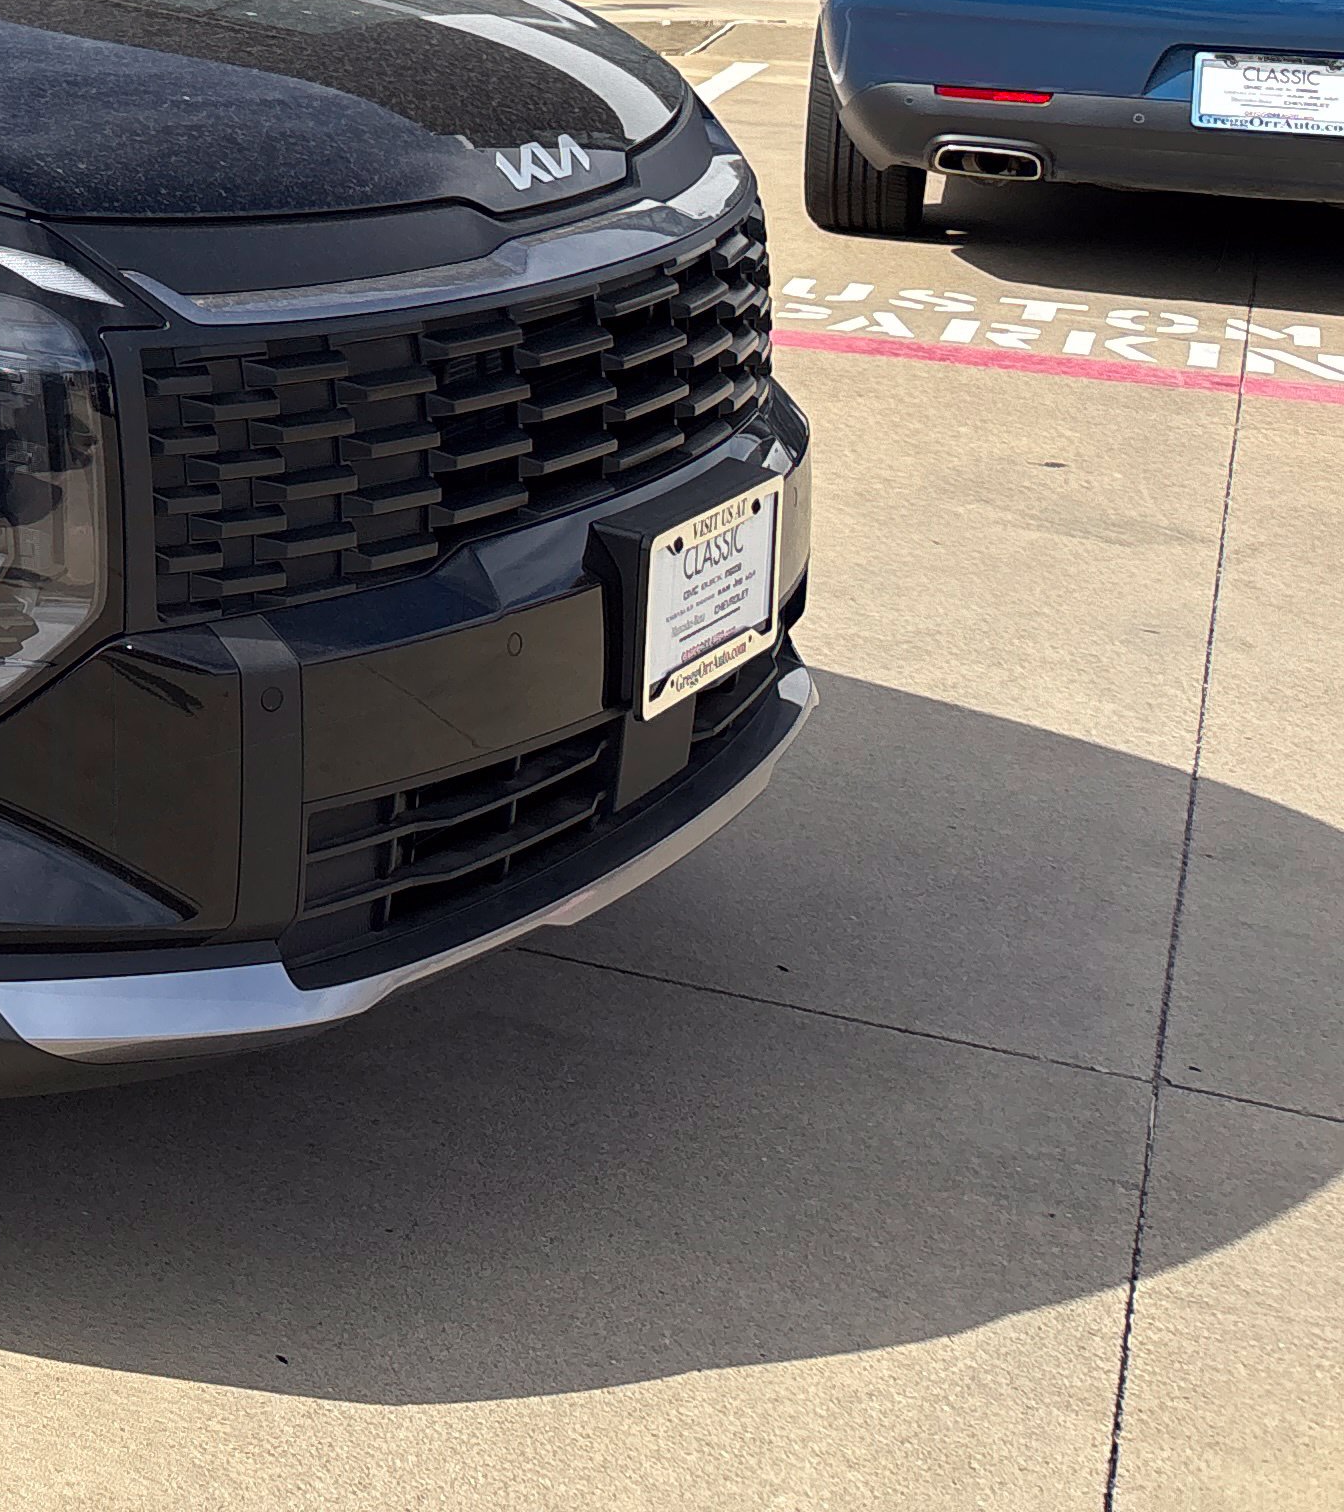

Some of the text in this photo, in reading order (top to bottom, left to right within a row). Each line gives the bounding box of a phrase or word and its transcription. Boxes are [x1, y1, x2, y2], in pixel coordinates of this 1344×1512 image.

[1242, 66, 1320, 86] CLASSIC
[496, 134, 590, 191] KIA
[781, 277, 1321, 348] USTOM
[692, 498, 748, 539] VISIT US AT
[683, 522, 744, 581] CLASSIC
